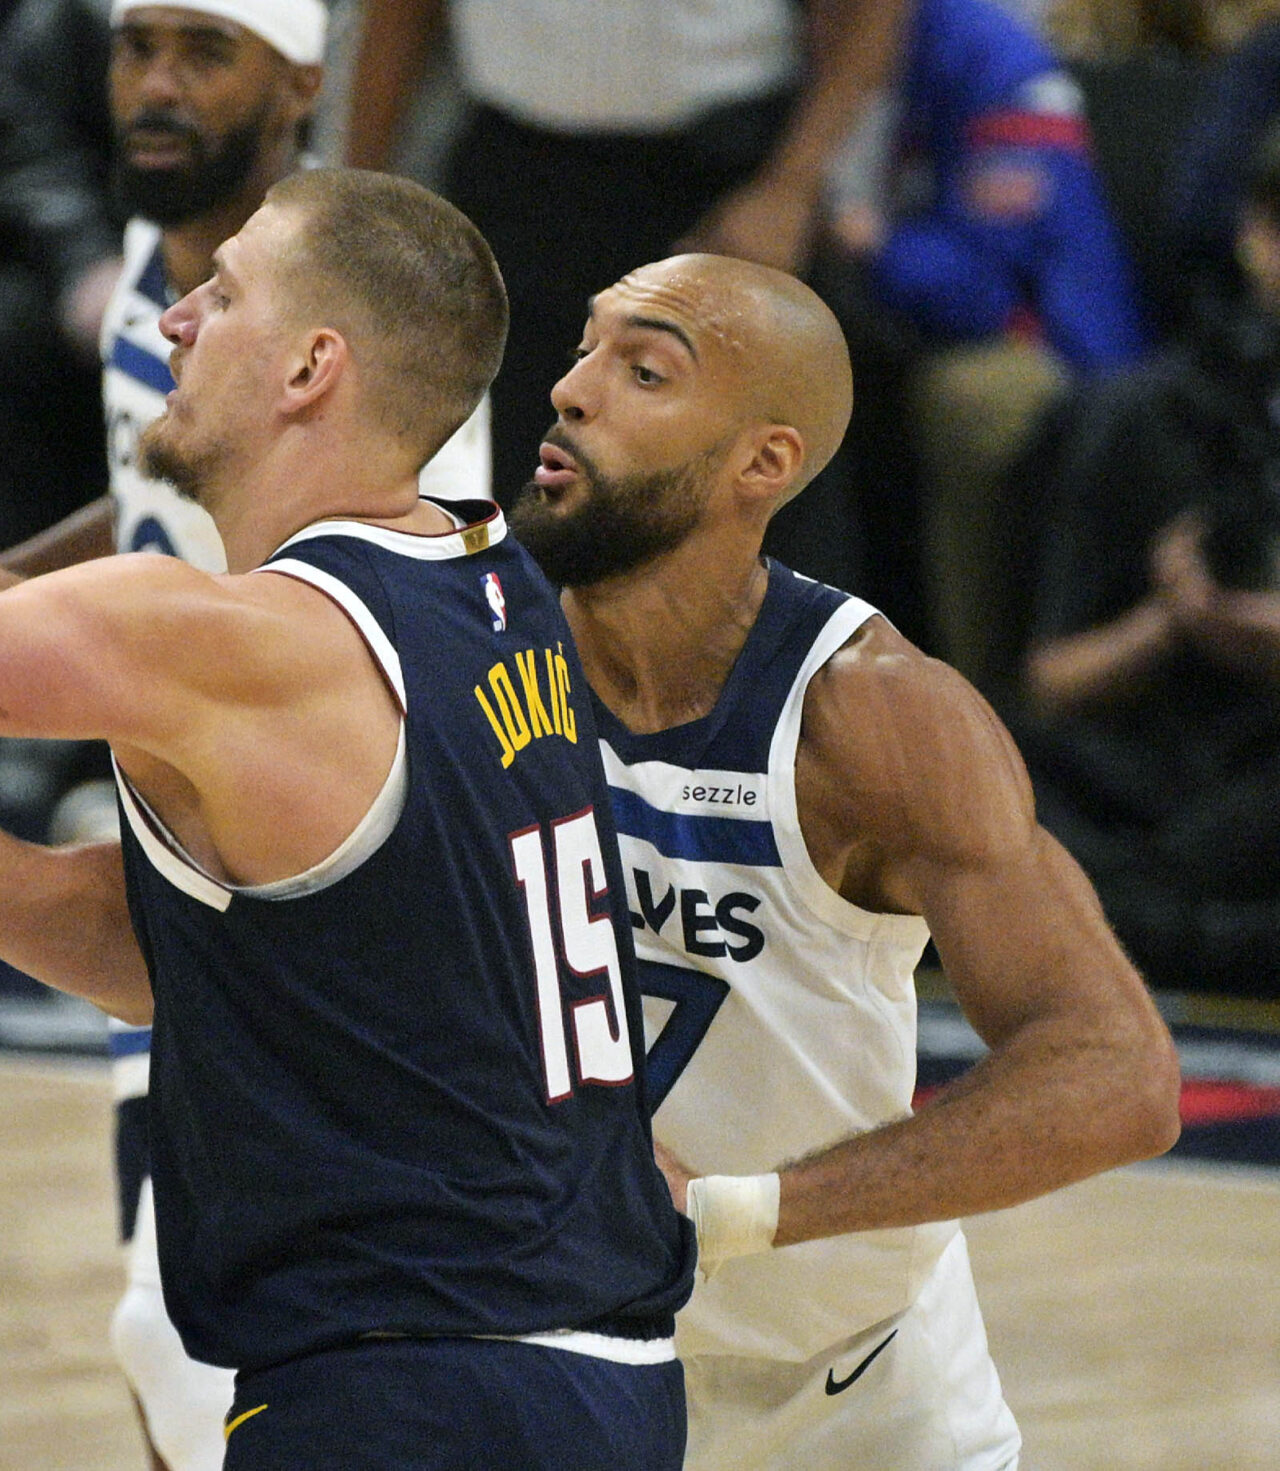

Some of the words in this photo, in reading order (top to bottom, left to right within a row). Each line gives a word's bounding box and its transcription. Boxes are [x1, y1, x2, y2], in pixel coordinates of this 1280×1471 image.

[474, 641, 578, 769] JOKIĆ
[682, 784, 757, 806] sezzle
[508, 804, 634, 1105] 15
